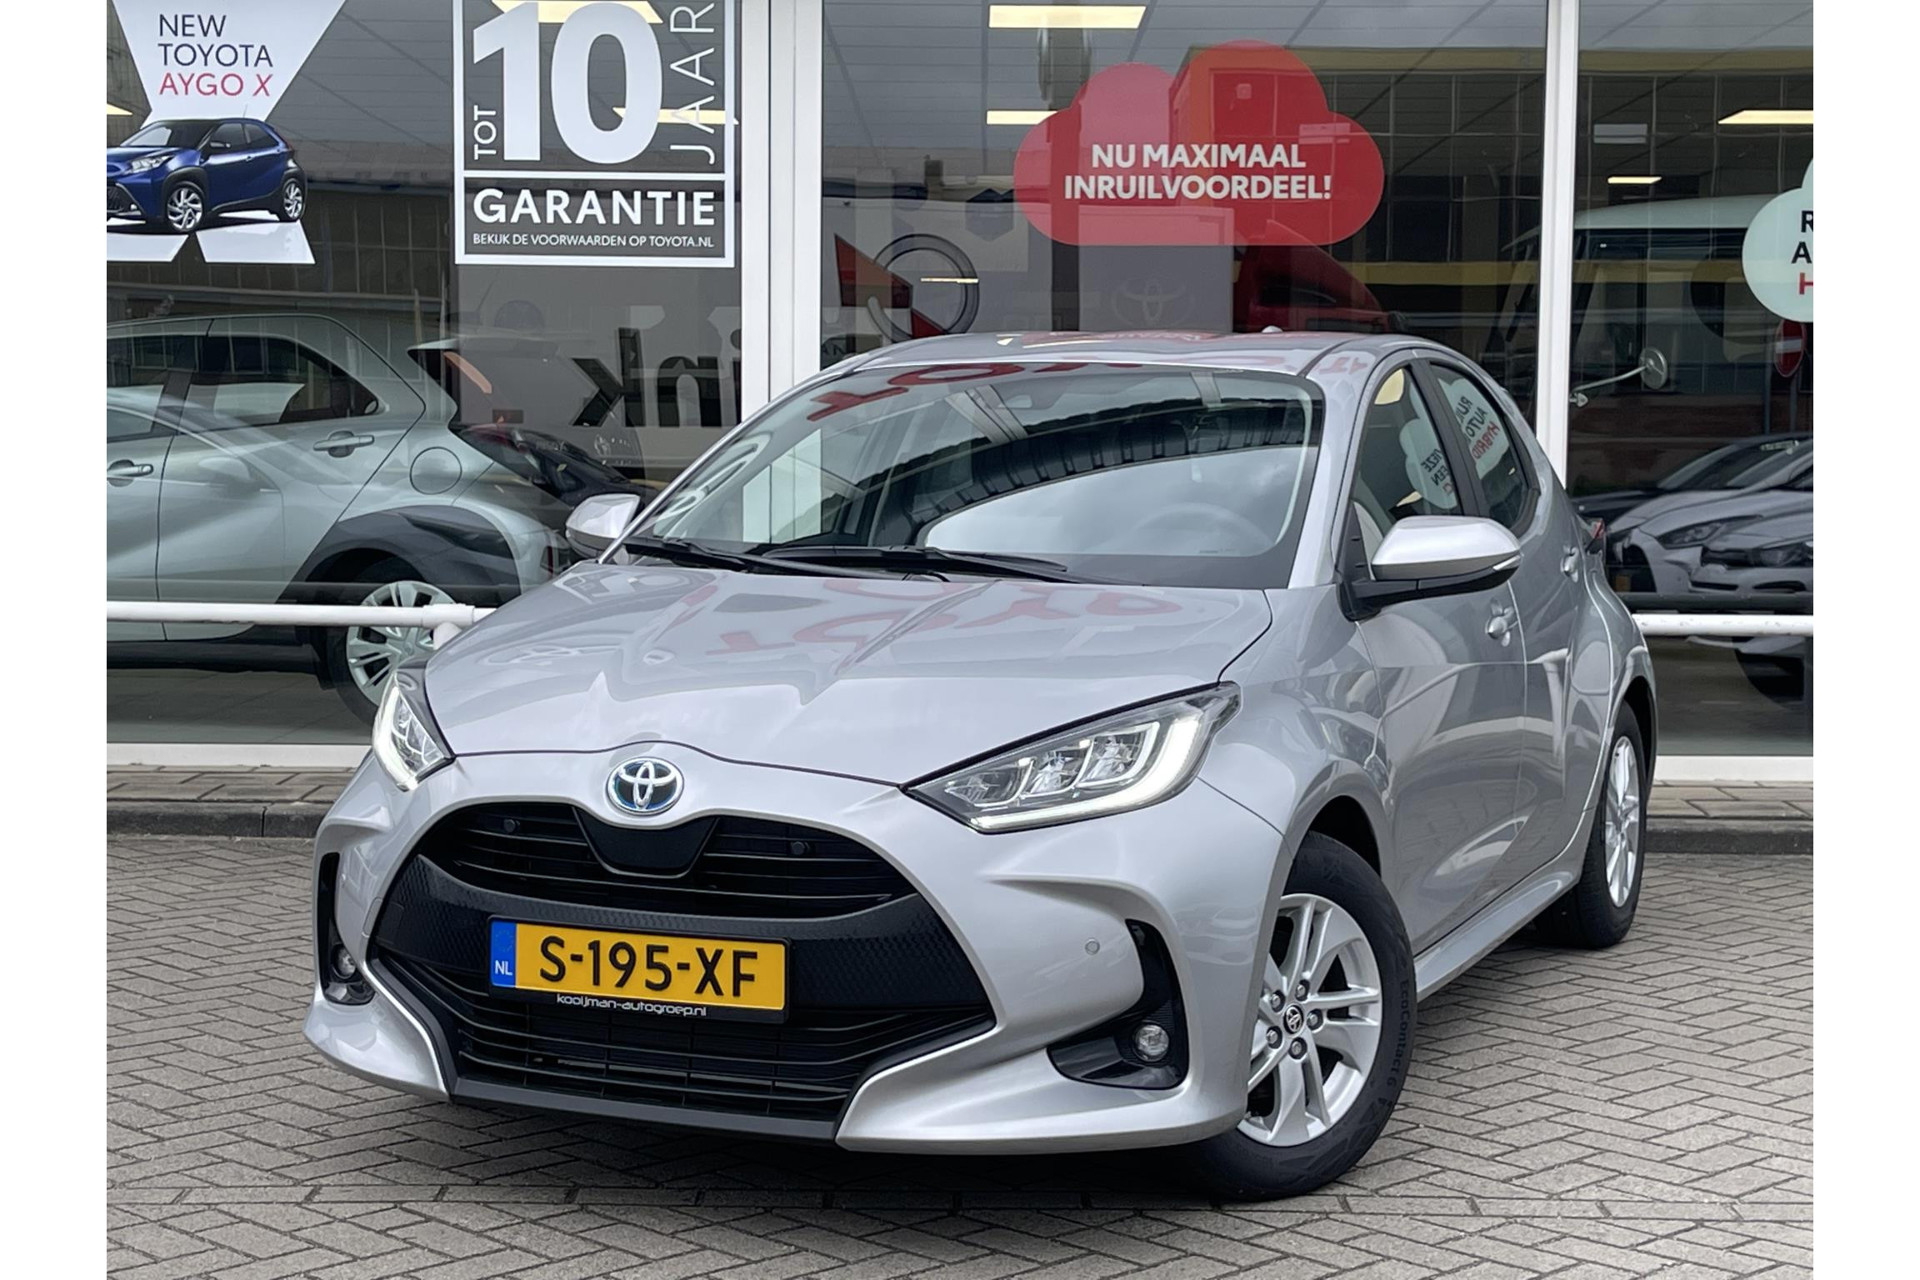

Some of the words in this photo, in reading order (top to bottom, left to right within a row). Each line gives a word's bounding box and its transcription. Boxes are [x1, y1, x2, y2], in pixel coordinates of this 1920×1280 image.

[159, 13, 227, 37] NEW
[157, 43, 273, 67] TOYOTA
[159, 72, 244, 96] AYGO
[252, 74, 274, 97] X
[473, 1, 663, 164] 10
[669, 2, 715, 165] JAAR
[473, 105, 497, 160] TOT
[1091, 143, 1137, 168] NU
[1142, 143, 1306, 169] MAXIMAAL
[1064, 174, 1332, 200] INRUILVOORDEEL!
[472, 187, 715, 227] GARANTIE
[472, 233, 511, 246] BEKIJK
[512, 234, 529, 246] DE
[531, 234, 627, 247] VOORWAARDEN
[628, 235, 647, 248] OP
[649, 235, 715, 249] TOYOTA.NL
[494, 960, 513, 976] NL
[539, 934, 759, 998] S-195-XF
[556, 993, 708, 1017] kooijman-autogroep.nl
